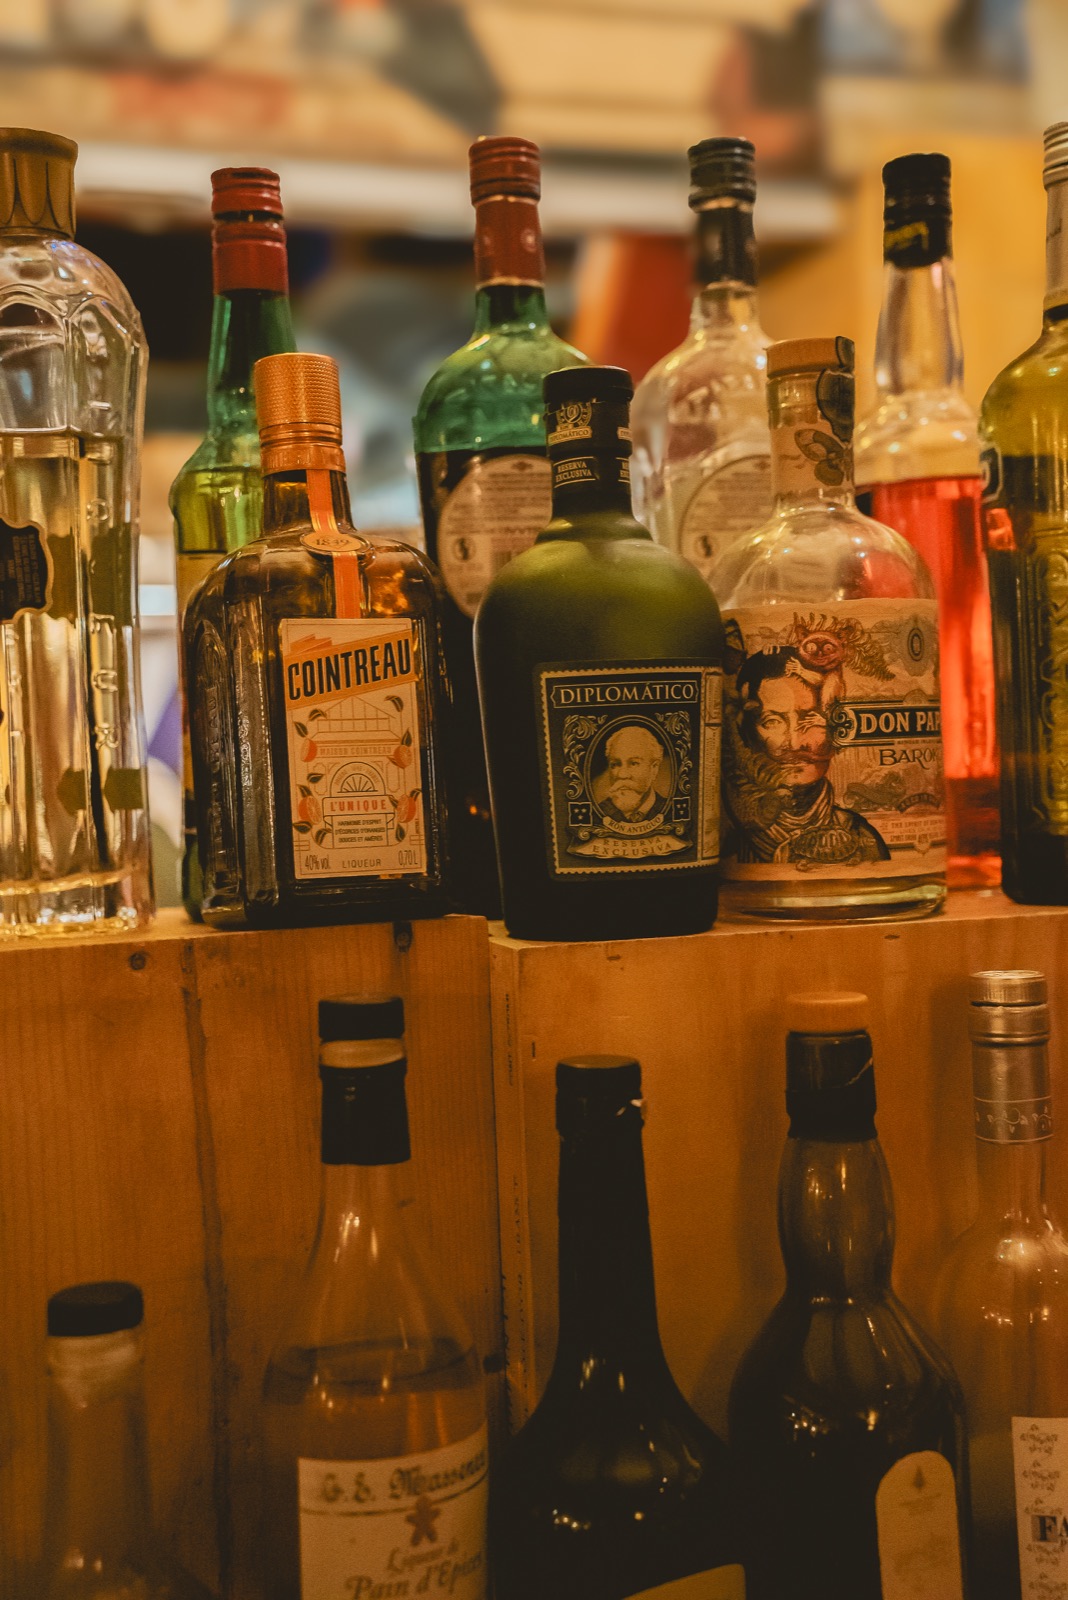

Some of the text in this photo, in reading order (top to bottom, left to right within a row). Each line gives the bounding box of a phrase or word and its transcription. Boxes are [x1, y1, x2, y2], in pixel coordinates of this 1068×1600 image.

[557, 460, 588, 474] RESERVA
[555, 468, 592, 483] EXCLUSIVA
[287, 638, 412, 700] COINTREAU
[560, 683, 695, 704] DIPLOMÁTICO
[859, 711, 911, 734] DON
[330, 799, 387, 812] L'UNIQUE
[608, 816, 662, 833] RON ANTIGUO
[592, 842, 672, 857] EXCLUSIVA
[603, 836, 662, 848] RESERVA
[342, 858, 382, 869] LIQUEUR
